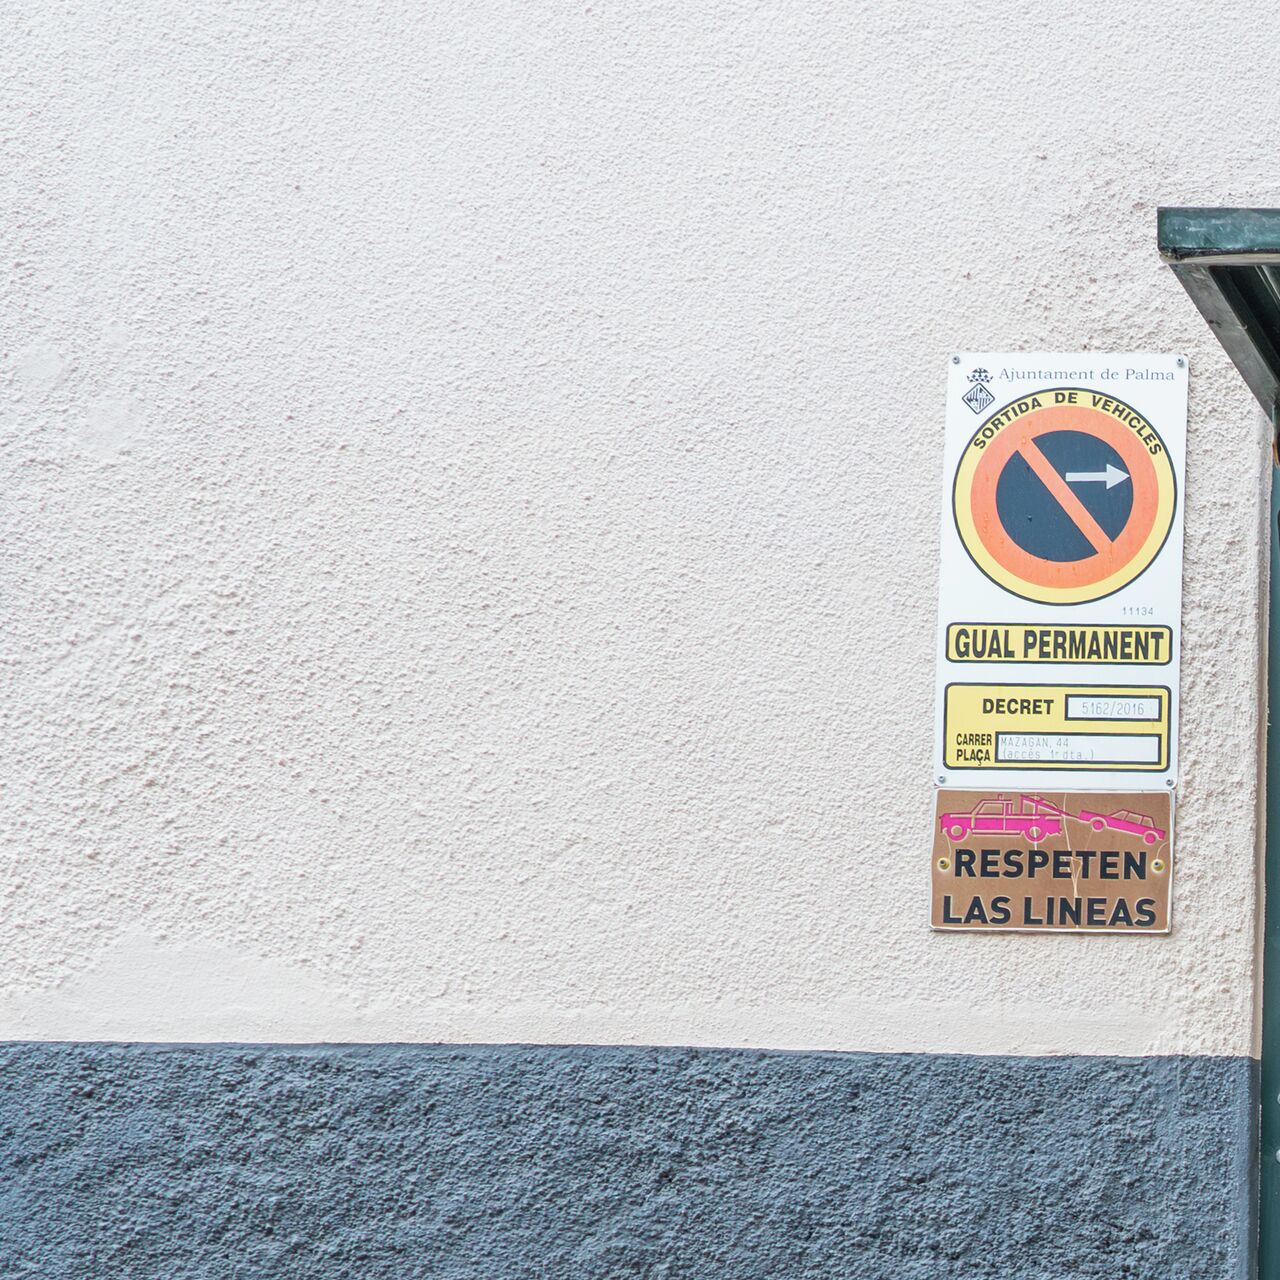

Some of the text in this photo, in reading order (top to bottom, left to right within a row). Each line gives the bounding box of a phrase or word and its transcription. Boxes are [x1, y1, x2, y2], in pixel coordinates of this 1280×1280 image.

[999, 368, 1175, 381] Ajuntament de Palma
[973, 392, 1162, 455] SORTIDA DE VEHICLES
[1122, 607, 1154, 616] 11134
[955, 628, 1164, 660] GUAL PERMANENT
[982, 698, 1145, 715] DECRET 5162/2016
[956, 733, 992, 746] CARRER
[1056, 738, 1069, 747] 44
[956, 749, 991, 766] PLAÇA
[954, 849, 1147, 880] RESPETEN
[943, 895, 1157, 927] LAS LINEAS
